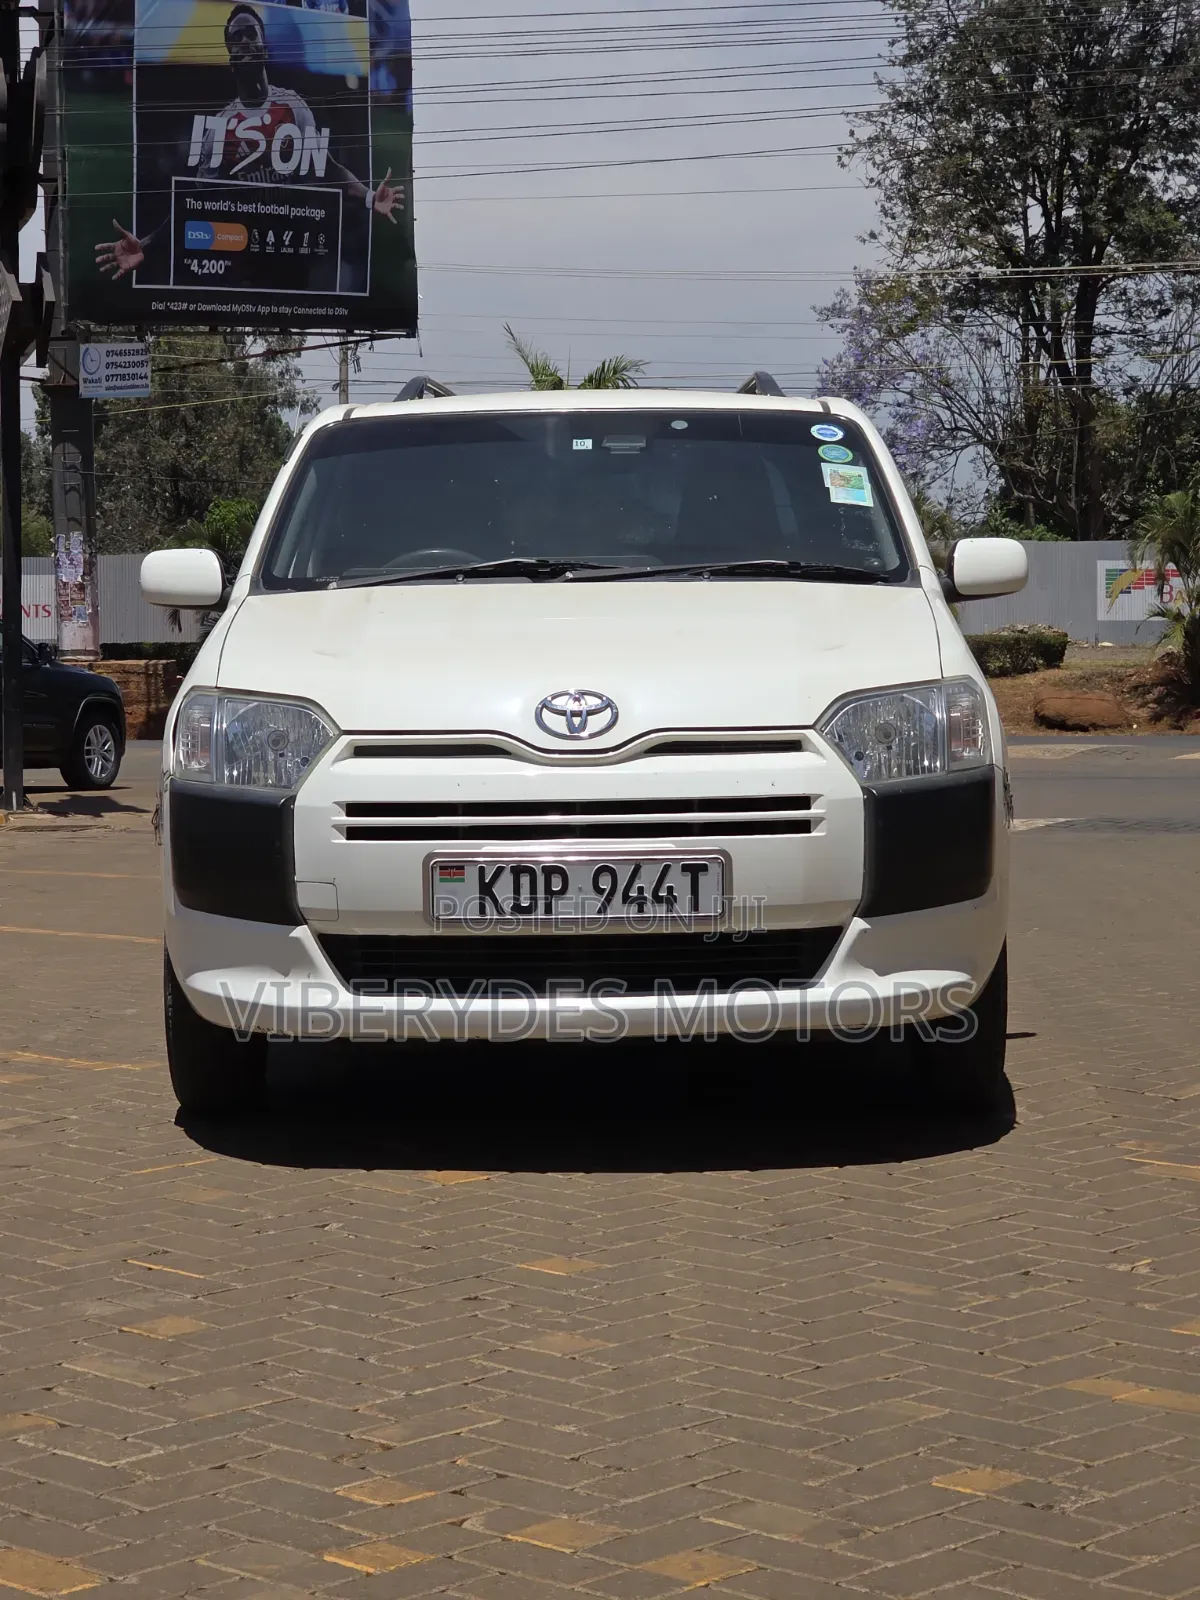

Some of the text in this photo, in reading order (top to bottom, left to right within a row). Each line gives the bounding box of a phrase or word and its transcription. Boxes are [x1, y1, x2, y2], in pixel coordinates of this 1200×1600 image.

[187, 114, 330, 177] IT'S ON
[185, 198, 326, 221] The world's best football package
[187, 231, 244, 242] DStv Compact
[190, 259, 225, 275] 4,200
[151, 301, 166, 310] Dial
[189, 303, 197, 311] or
[197, 302, 231, 312] Download
[231, 303, 257, 315] MyDStv
[257, 305, 271, 316] App
[271, 305, 278, 313] to
[278, 305, 292, 316] stay
[293, 306, 327, 315] Connected
[327, 307, 334, 315] to
[334, 307, 349, 316] DStv
[105, 360, 149, 370] 0754230057
[104, 372, 149, 382] 0771830144
[478, 864, 569, 916] KDP
[591, 862, 709, 914] 944T
